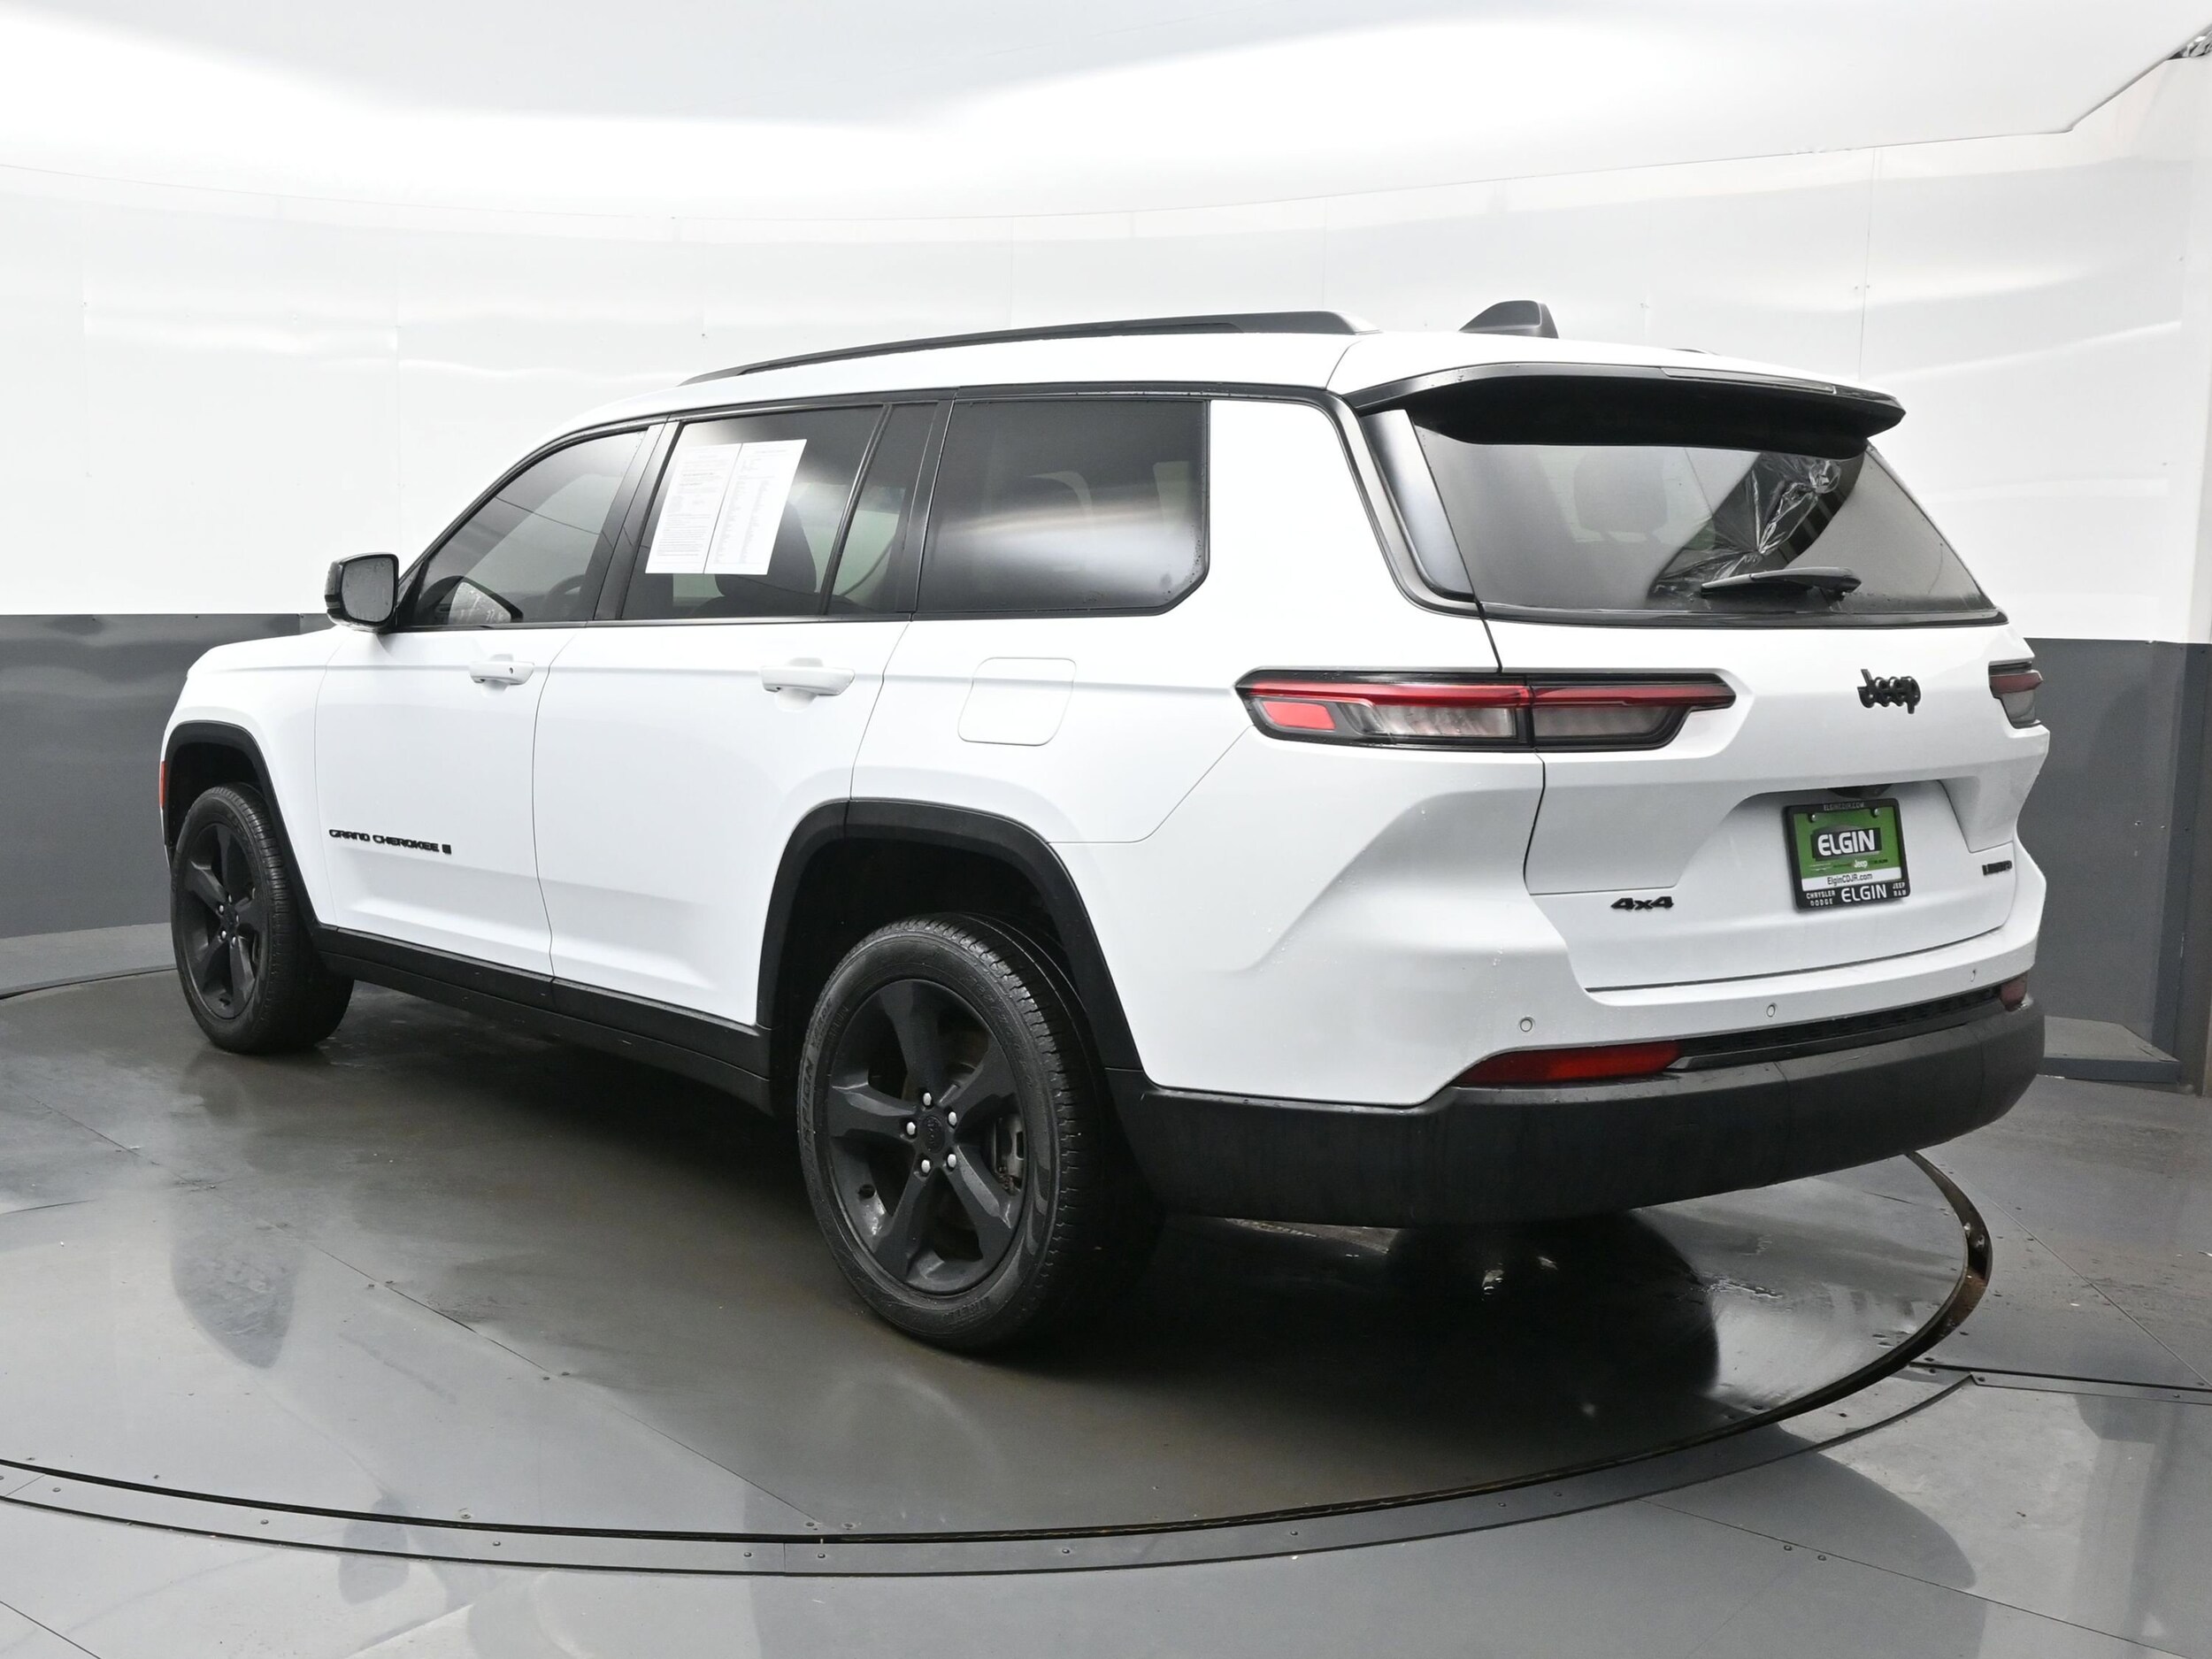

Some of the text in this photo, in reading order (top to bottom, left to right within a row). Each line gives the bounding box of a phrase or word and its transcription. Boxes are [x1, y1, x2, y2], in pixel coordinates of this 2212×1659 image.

[1857, 669, 1921, 714] Jeep
[329, 829, 371, 842] GRAND
[373, 834, 440, 852] CHEROKEE
[1817, 830, 1875, 856] ELGIN
[1854, 859, 1868, 869] Jeep
[1827, 872, 1873, 886] ElginCDJR.com
[1806, 890, 1836, 900] CHRYSLER
[1841, 884, 1887, 902] ELGIN
[1610, 896, 1674, 911] 4x4
